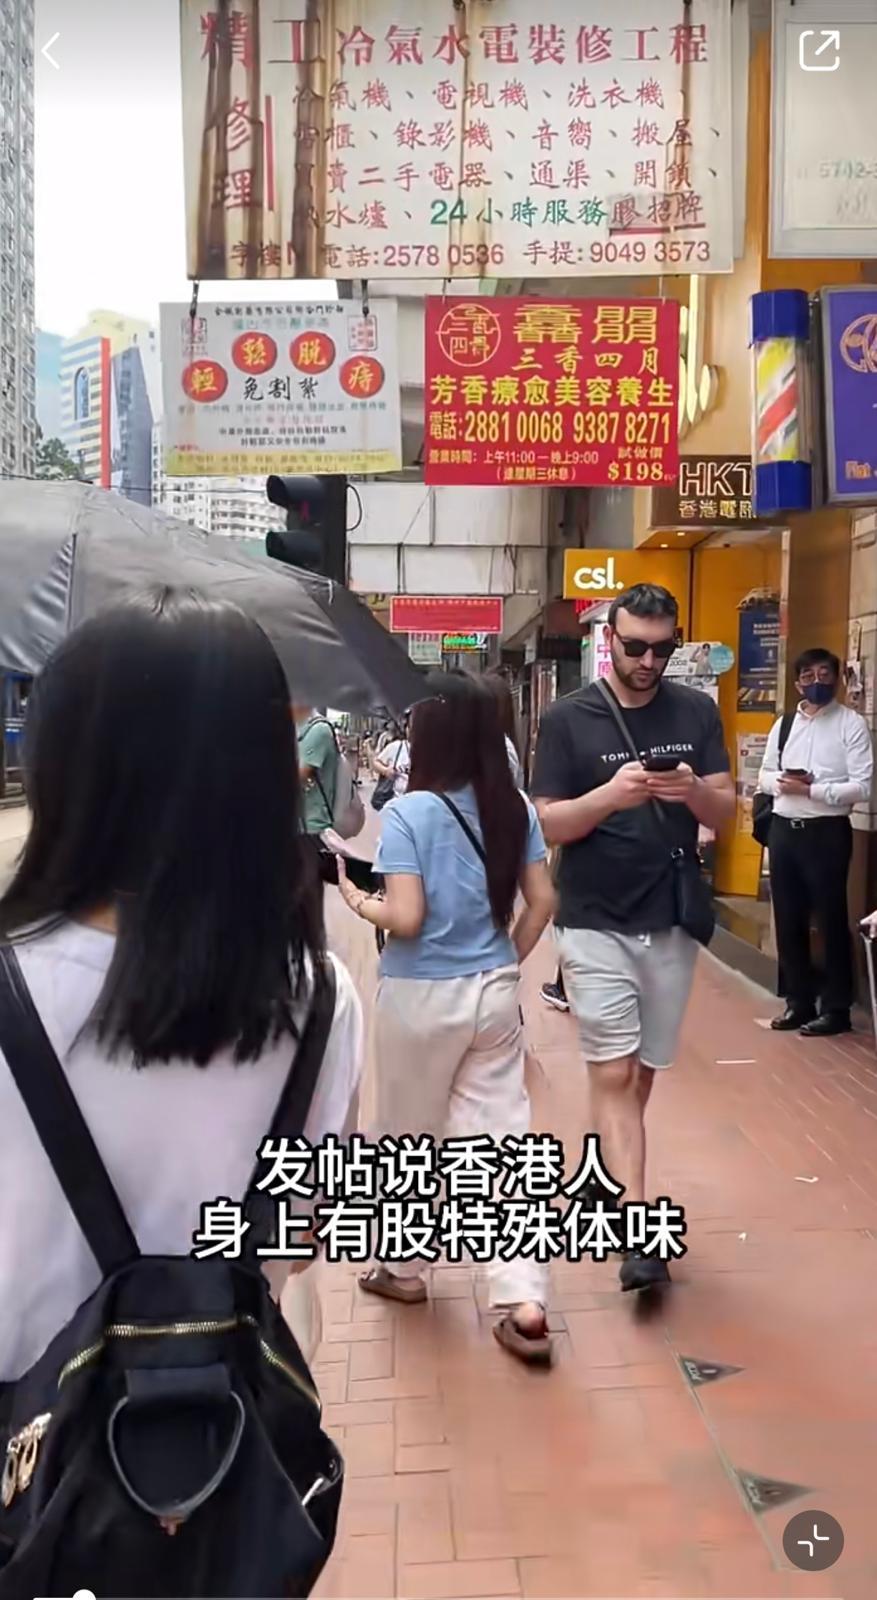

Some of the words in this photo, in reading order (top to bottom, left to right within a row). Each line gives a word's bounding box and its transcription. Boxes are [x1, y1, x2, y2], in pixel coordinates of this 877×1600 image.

[448, 244, 504, 267] 0536
[654, 241, 710, 262] 3573
[512, 347, 658, 376] 三香四月
[430, 375, 674, 407] 芳香療愈美容養生
[517, 411, 563, 443] 0068
[573, 411, 620, 443] 9387
[625, 411, 670, 443] 8271
[607, 461, 664, 481] $198
[573, 557, 624, 590] csl.
[650, 743, 694, 755] HILFIGER
